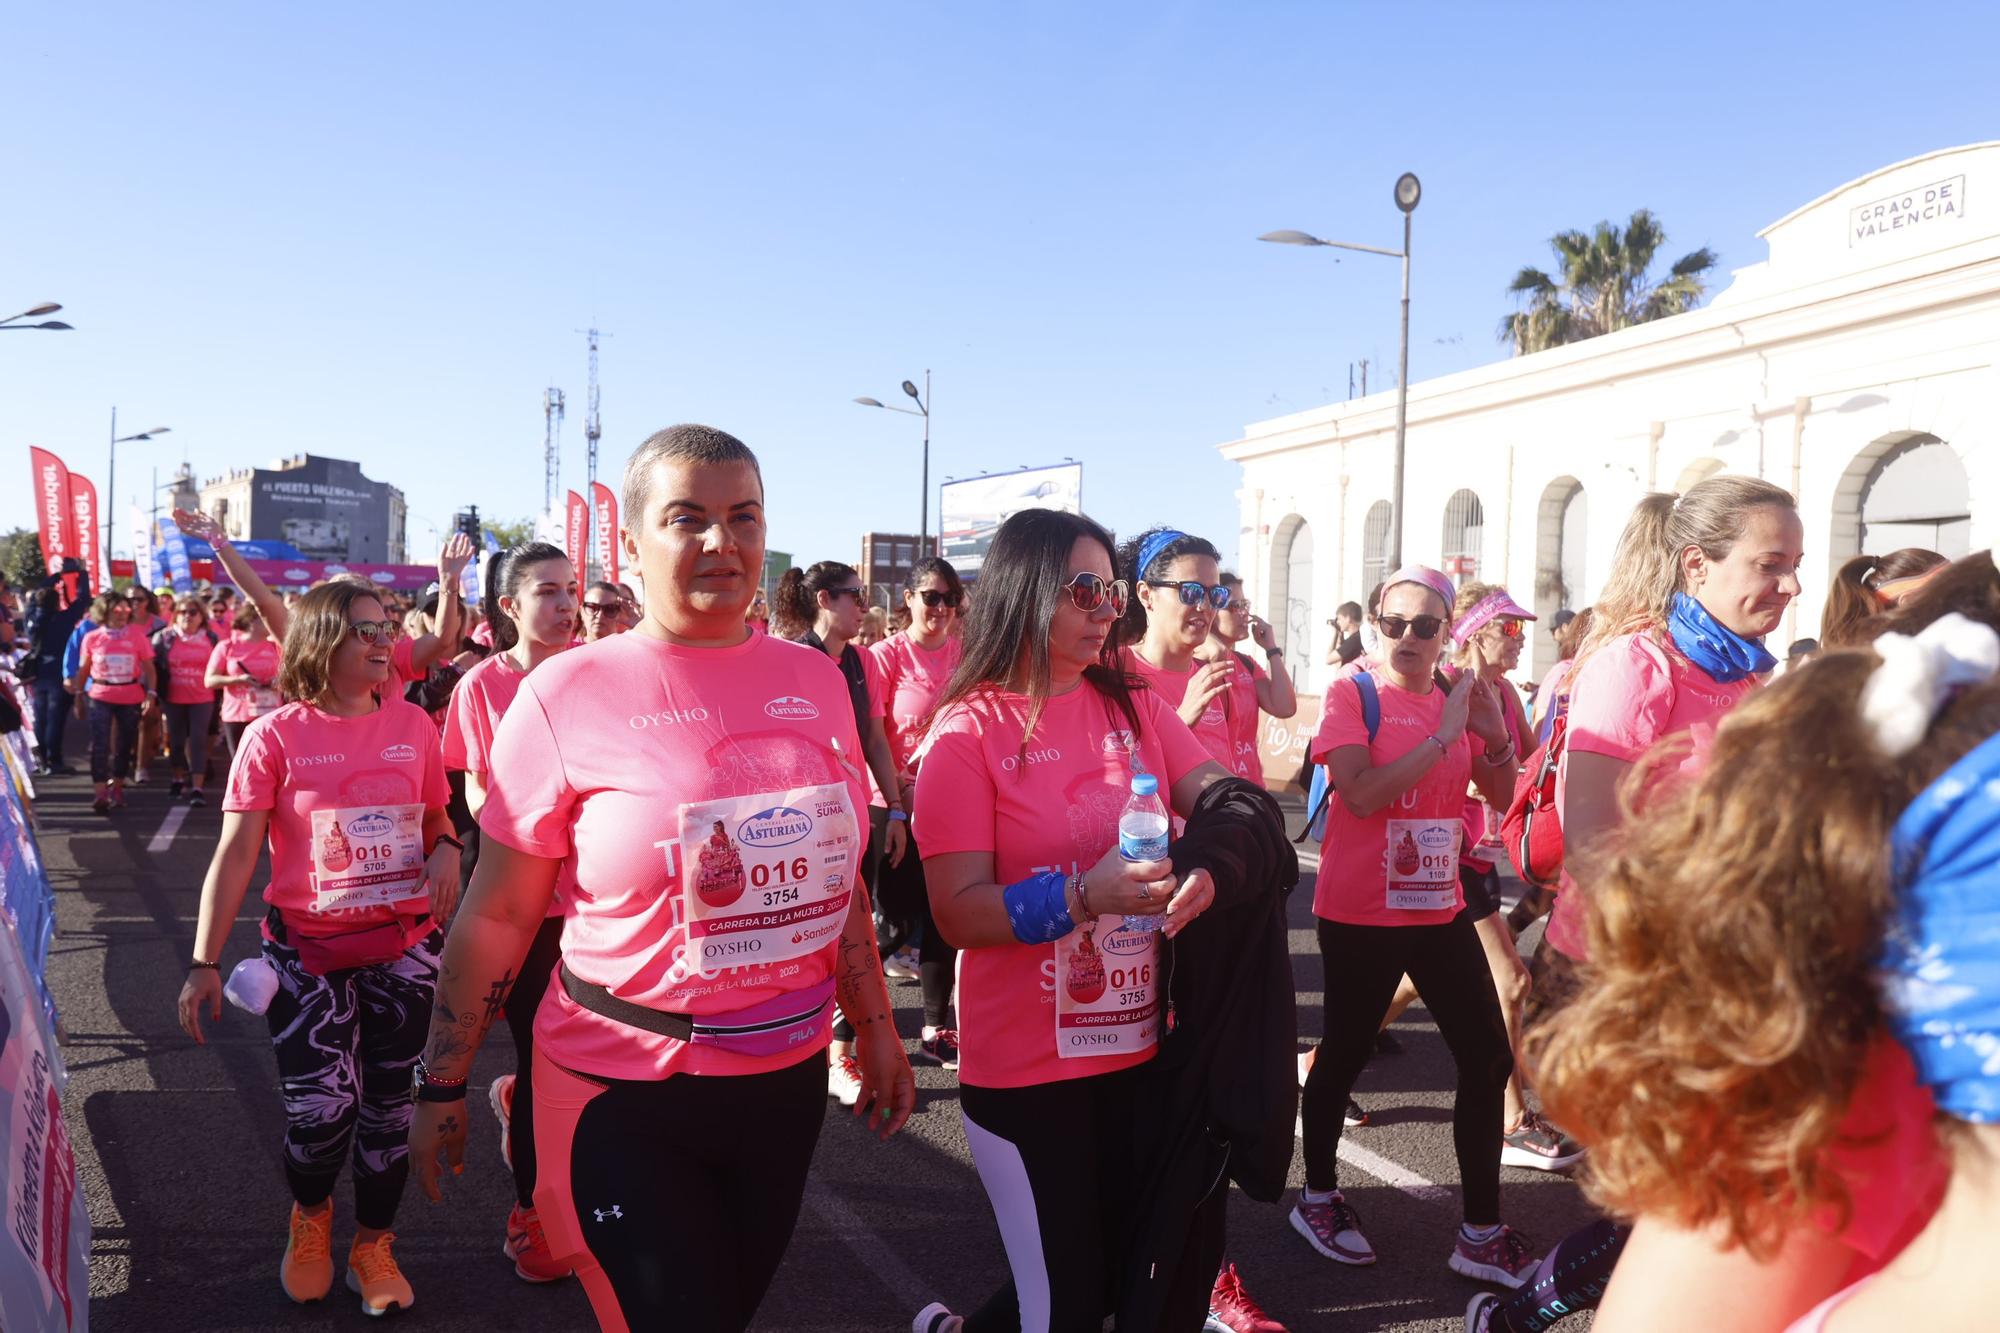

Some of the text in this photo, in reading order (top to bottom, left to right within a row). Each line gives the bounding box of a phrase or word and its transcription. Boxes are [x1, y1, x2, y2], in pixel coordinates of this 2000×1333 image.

[1860, 183, 1953, 222] GRAO DE
[1856, 201, 1955, 239] VALENCIA
[629, 706, 708, 730] OYSHO
[296, 753, 345, 767] OYSHO
[816, 807, 844, 818] SUMA
[351, 821, 392, 834] ASTURIANA
[744, 821, 809, 841] ASTURIANA
[355, 843, 393, 861] 016
[363, 861, 387, 873] 5705
[1422, 855, 1450, 869] 016
[751, 857, 809, 888] 016
[1428, 870, 1446, 879] 1109
[331, 879, 362, 889] CARRERA
[329, 892, 364, 903] OYSHO
[763, 887, 800, 906] 3754
[1396, 896, 1428, 904] OYSHO
[709, 899, 843, 932] CARRERA DE LA MUJER 2023
[704, 939, 762, 957] OYSHO
[666, 964, 799, 999] CARRERA DE LA MUJER 2023
[1110, 964, 1151, 989] 016
[1120, 990, 1146, 1006] 3755
[1075, 1015, 1117, 1025] CARRERA
[1119, 1013, 1131, 1022] DE
[1132, 1011, 1142, 1020] LA
[788, 1026, 815, 1045] FILA
[1071, 1033, 1118, 1047] OYSHO
